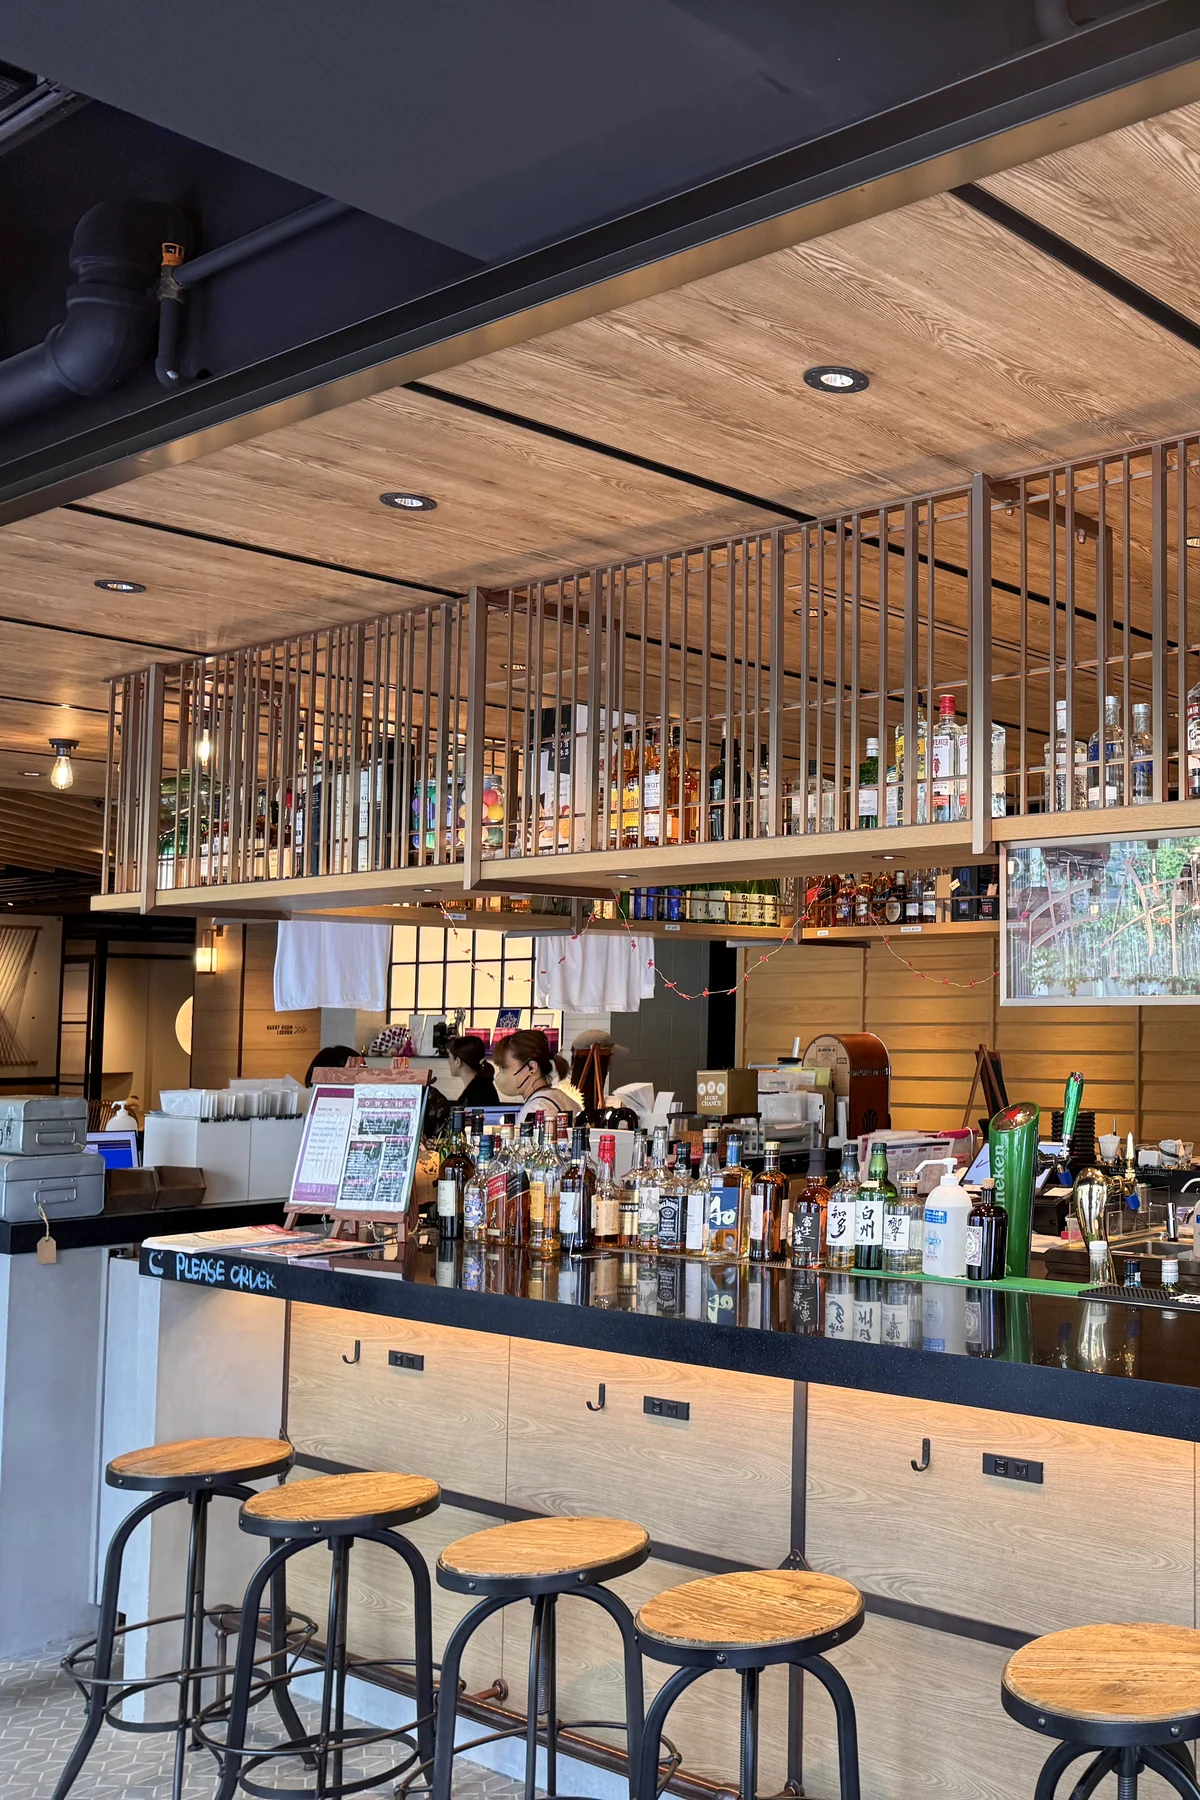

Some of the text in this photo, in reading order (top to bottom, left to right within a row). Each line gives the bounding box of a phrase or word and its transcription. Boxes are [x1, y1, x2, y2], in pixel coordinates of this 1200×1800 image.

[860, 1205, 875, 1240] 白州
[175, 1252, 277, 1290] PLEASE ORDER
